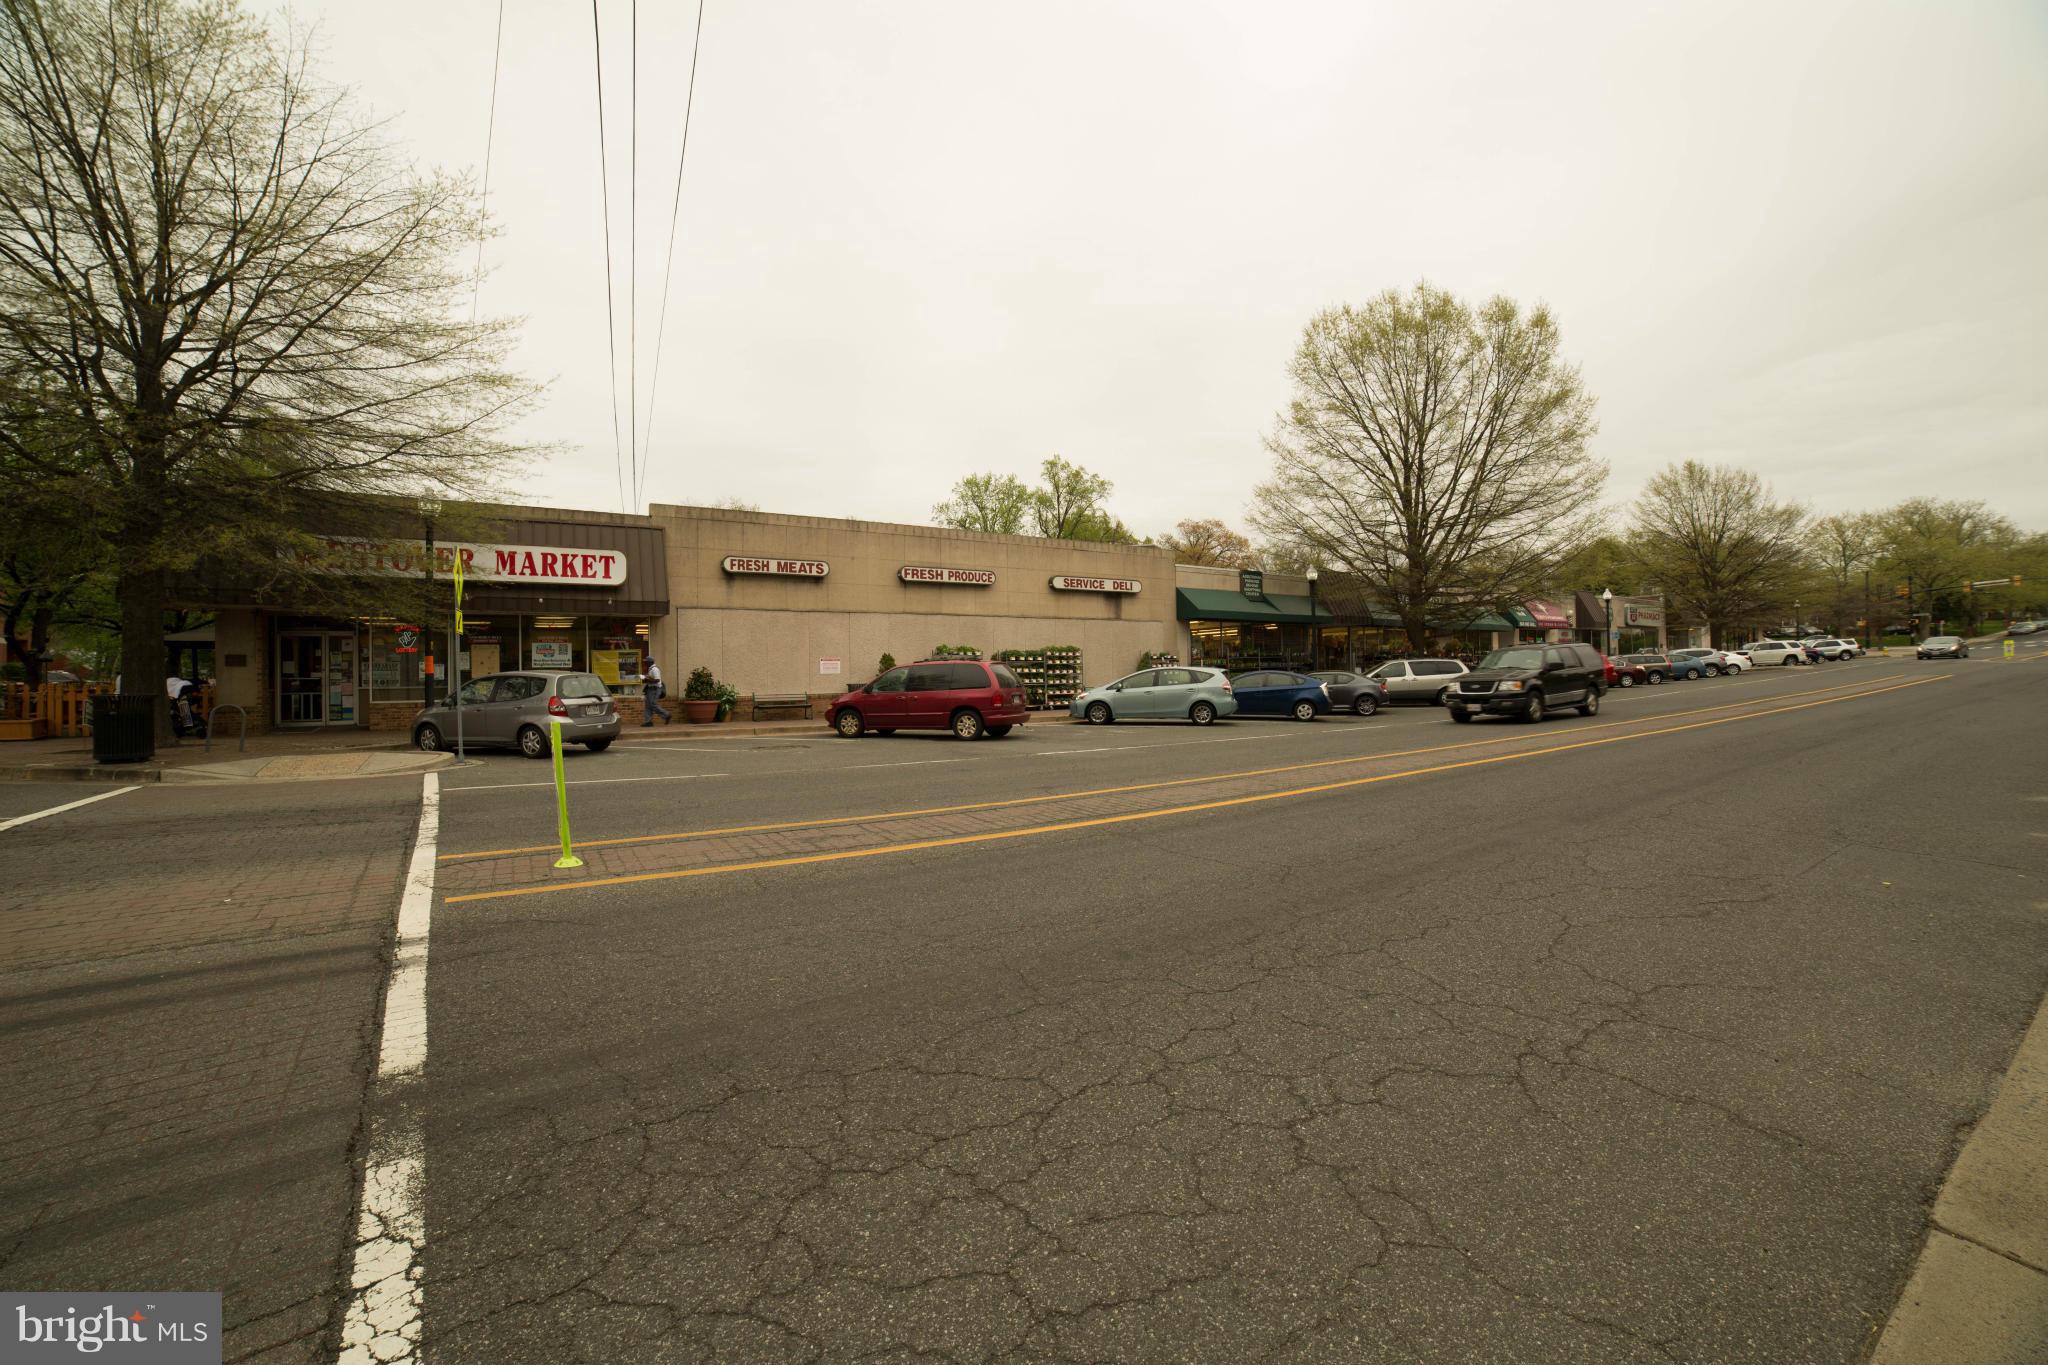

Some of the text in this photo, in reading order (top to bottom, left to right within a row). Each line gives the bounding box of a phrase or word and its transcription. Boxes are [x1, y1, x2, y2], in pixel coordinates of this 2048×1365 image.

[296, 540, 616, 579] ESTOVER MARKET
[730, 558, 825, 575] FRESH MEATS
[903, 568, 993, 583] FRESH PRODUCE
[1063, 577, 1133, 591] SERVICE DELI
